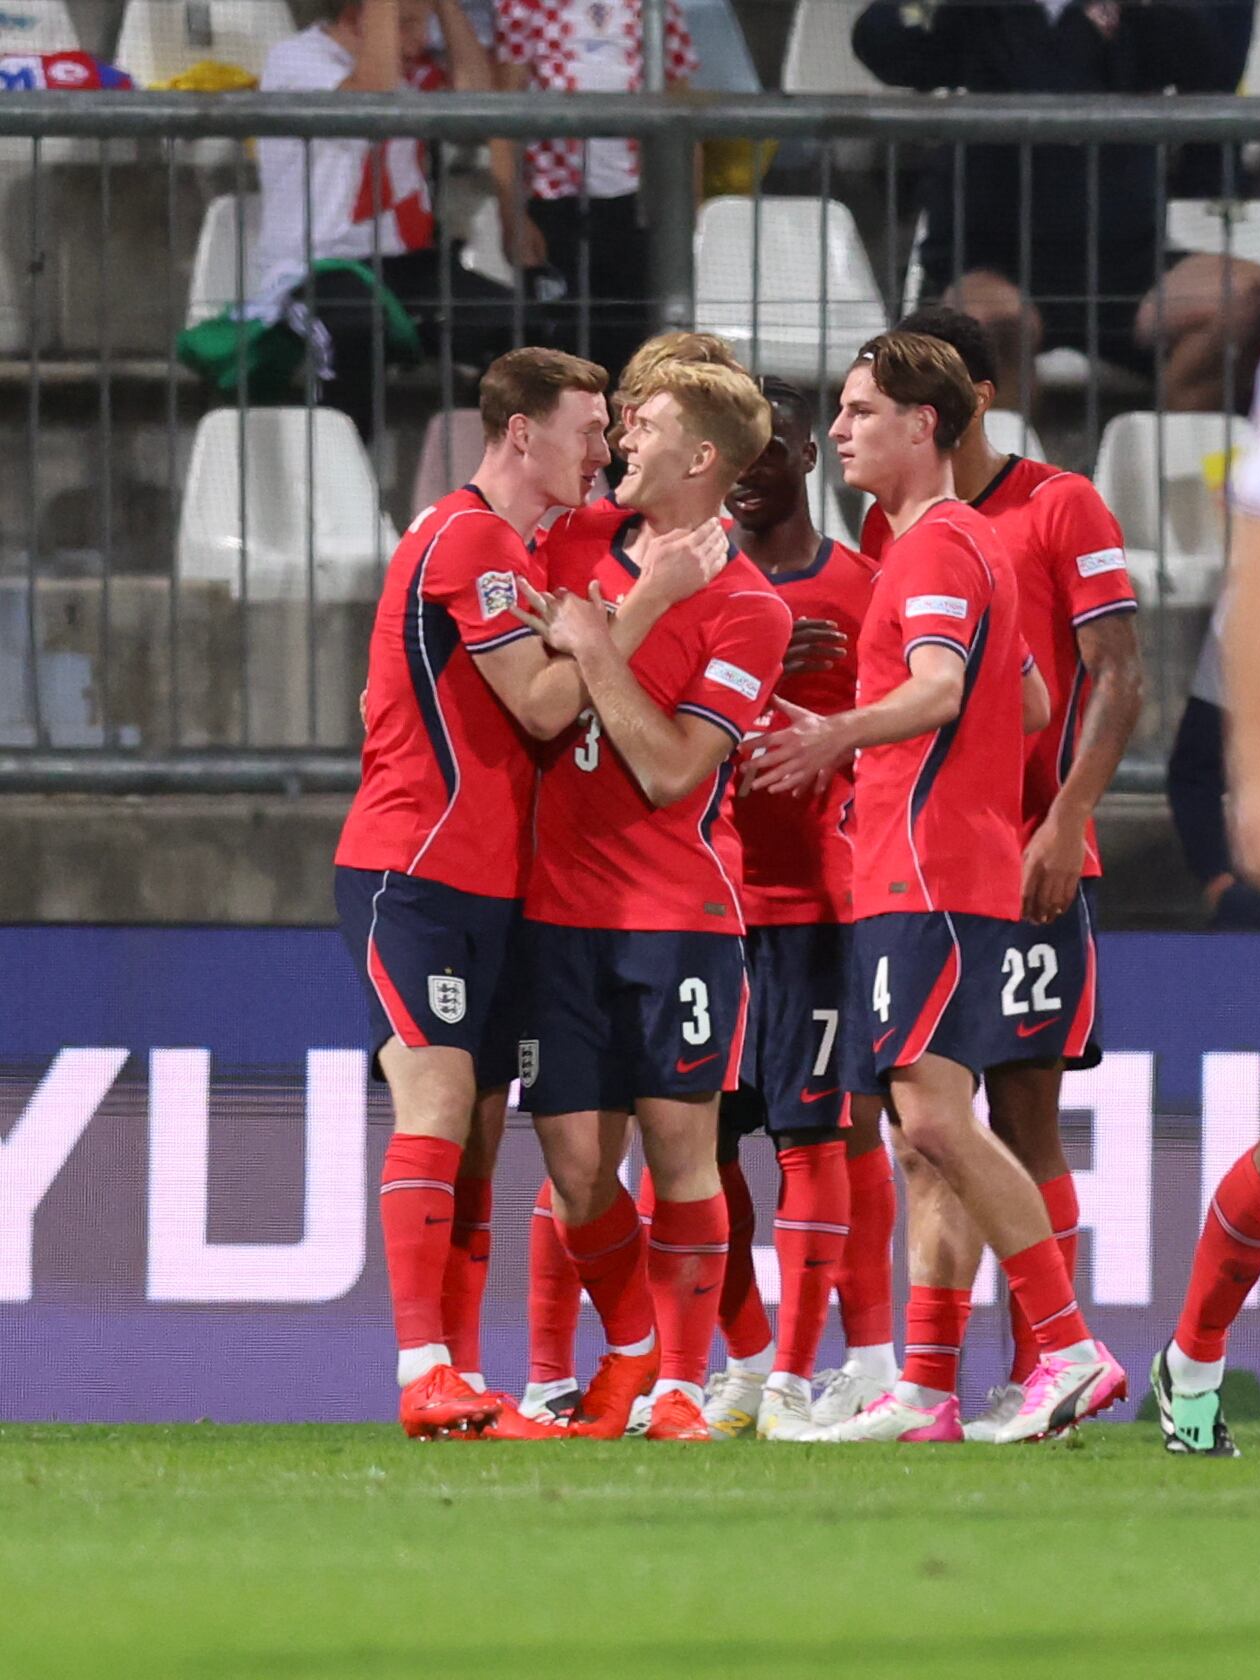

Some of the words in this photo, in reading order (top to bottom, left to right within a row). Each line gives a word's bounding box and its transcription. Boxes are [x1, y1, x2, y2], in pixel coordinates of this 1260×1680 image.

[574, 707, 600, 772] 3
[679, 977, 711, 1045] 3
[873, 955, 891, 1023] 4
[1001, 943, 1061, 1016] 22
[812, 1009, 839, 1076] 7
